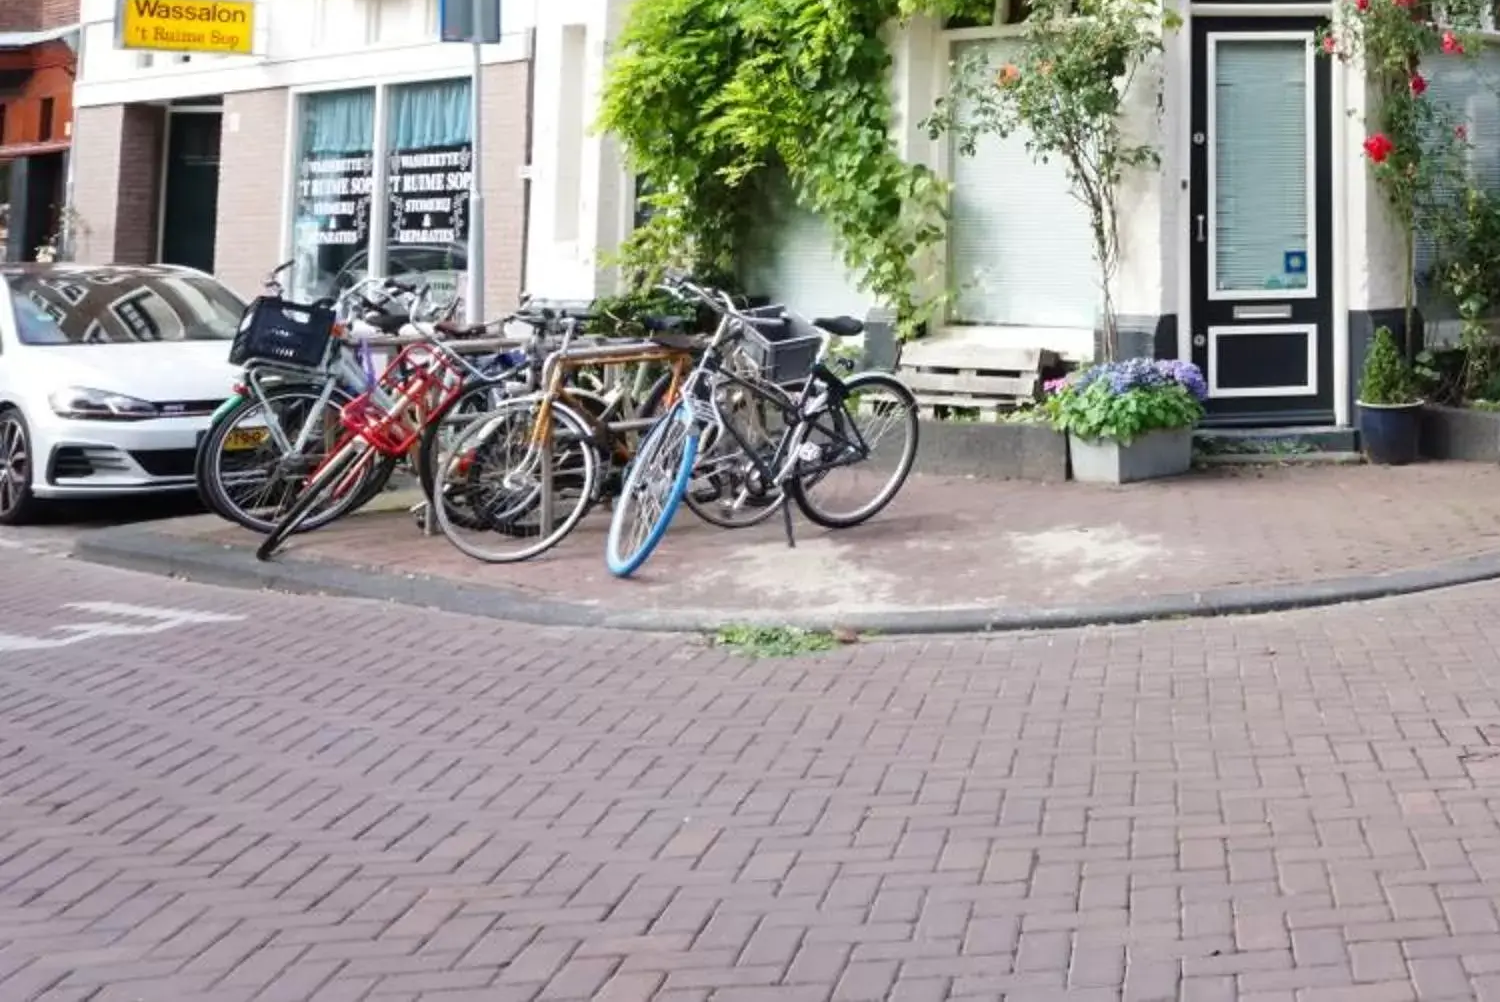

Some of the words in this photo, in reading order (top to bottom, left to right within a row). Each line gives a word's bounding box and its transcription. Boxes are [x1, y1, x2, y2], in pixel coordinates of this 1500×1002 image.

[153, 26, 206, 44] Ruime
[210, 29, 240, 51] Sop
[403, 173, 445, 191] RUIME
[446, 171, 472, 190] SOP
